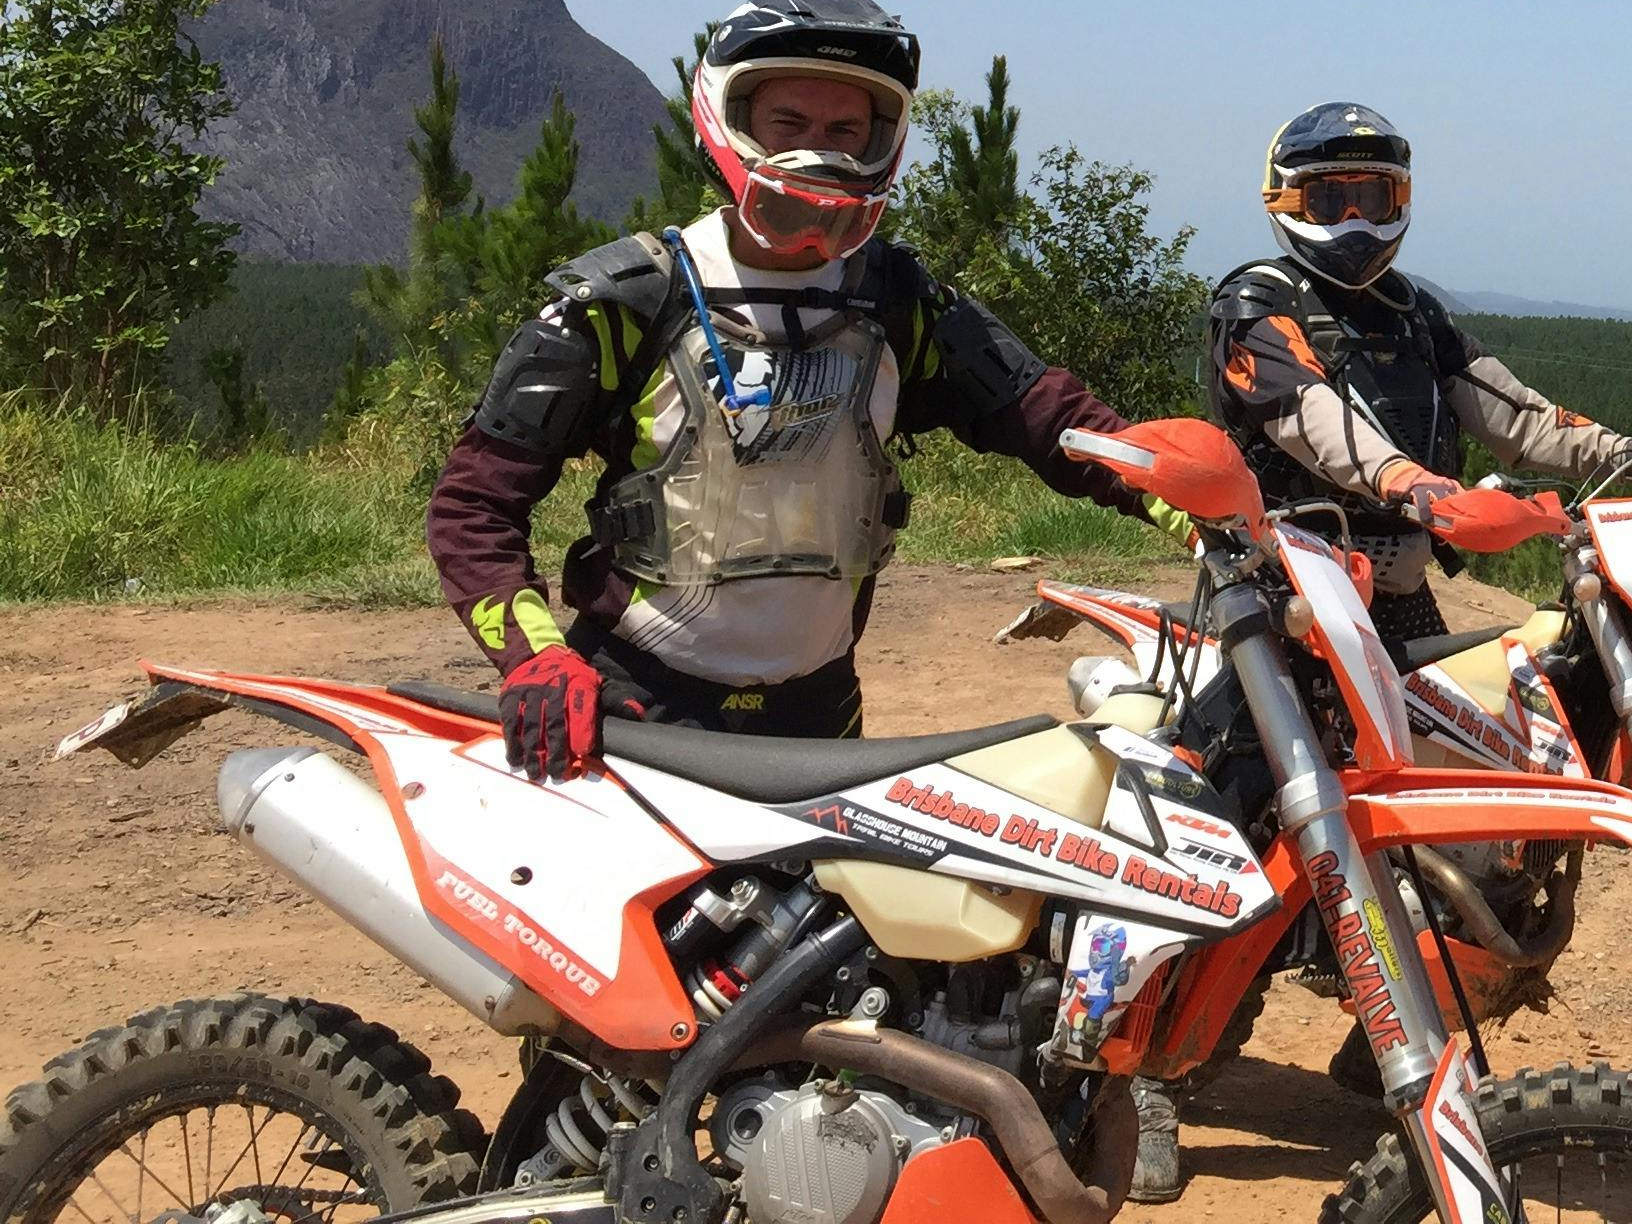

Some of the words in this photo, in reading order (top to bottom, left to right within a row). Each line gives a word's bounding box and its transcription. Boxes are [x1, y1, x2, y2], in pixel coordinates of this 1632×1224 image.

[721, 693, 764, 711] ANSR
[1405, 672, 1458, 722] Brisbane
[1457, 706, 1484, 742] Dirt
[1482, 725, 1510, 761] Bike
[885, 776, 1000, 838] Brisbane
[1000, 813, 1059, 857] Dirt
[1056, 832, 1119, 879] Bike
[1121, 854, 1243, 919] Rentals
[901, 827, 948, 852] MOUNTAIN
[1166, 813, 1232, 839] KTM
[436, 870, 498, 921] FUEL
[503, 912, 602, 998] TORQUE
[1306, 849, 1409, 1060] 041-REVALVE
[1439, 1098, 1484, 1157] Brisbane
